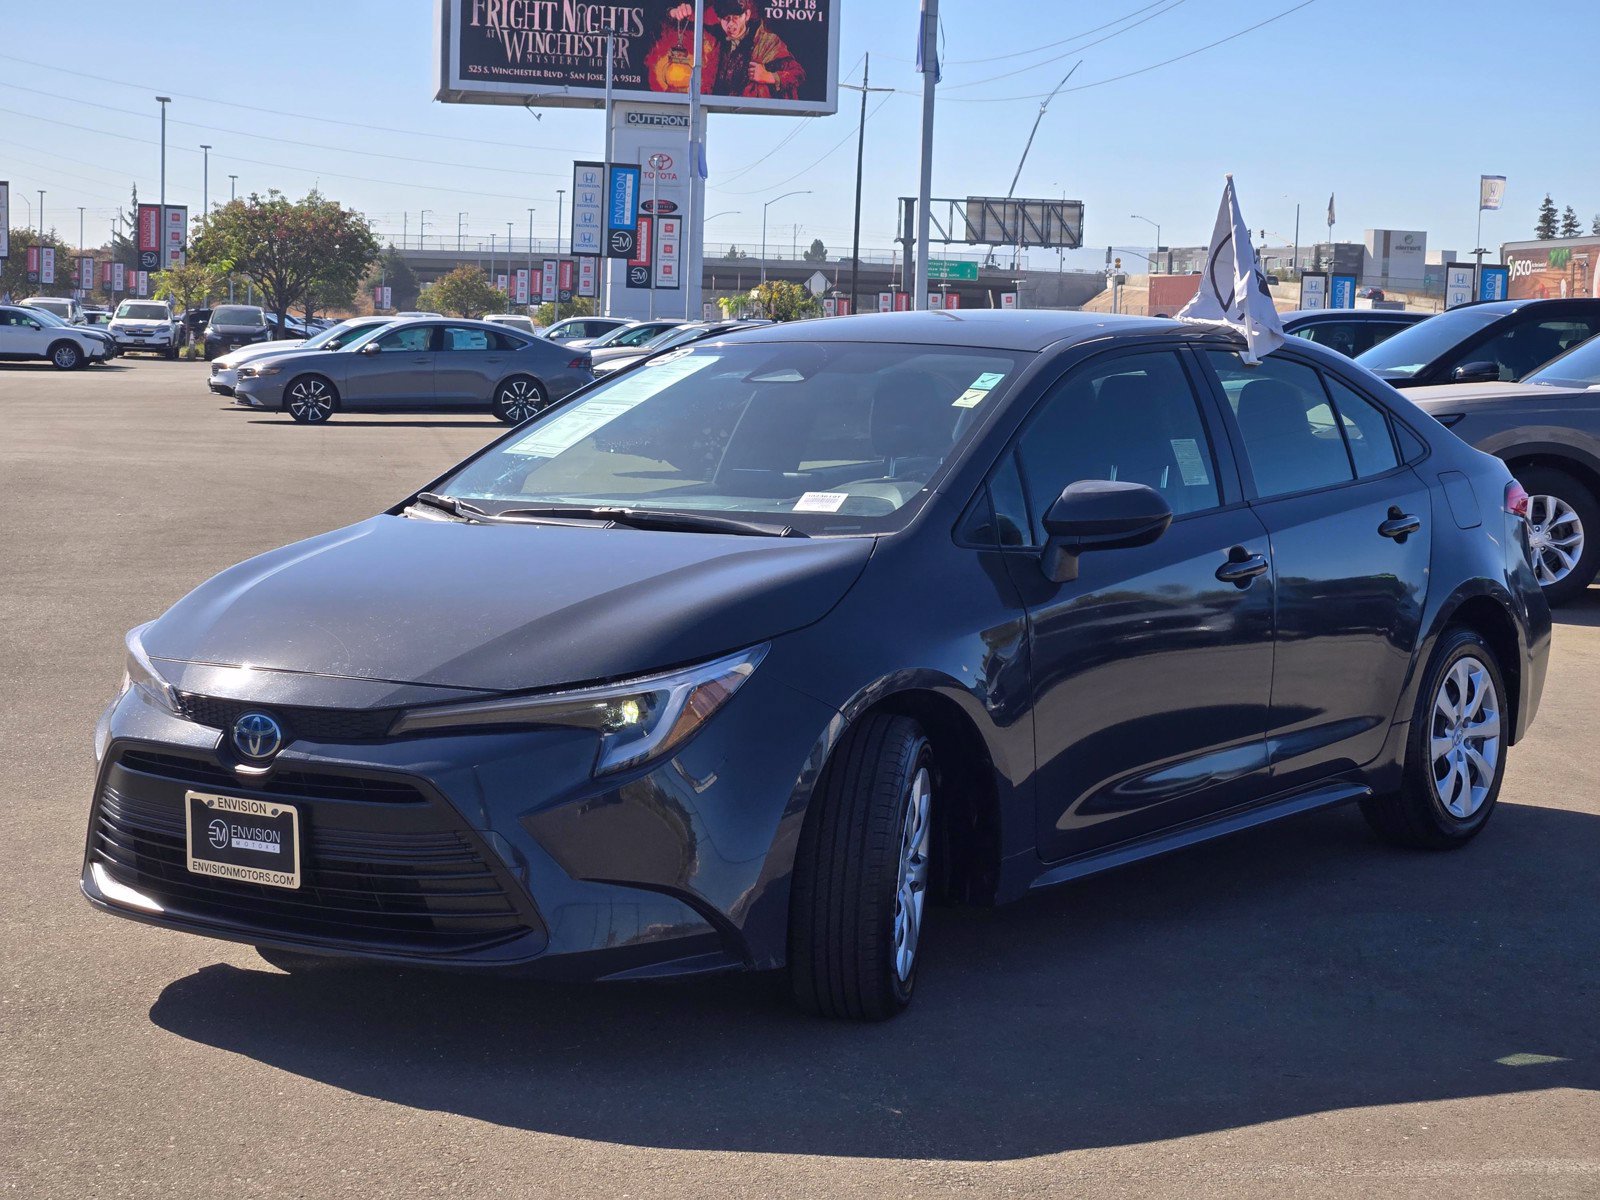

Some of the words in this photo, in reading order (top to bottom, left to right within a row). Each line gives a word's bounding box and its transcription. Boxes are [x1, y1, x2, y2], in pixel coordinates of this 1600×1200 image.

[771, 0, 799, 8] SEPT
[804, 0, 816, 9] 18
[470, 0, 558, 42] FRIGHT
[765, 7, 783, 19] TO
[786, 9, 816, 21] NOV
[818, 11, 823, 21] 1
[486, 29, 495, 38] AT
[501, 29, 631, 68] WINCHESTER
[526, 54, 580, 66] MYSTERY
[589, 57, 625, 69] HOSE
[468, 65, 482, 73] 525
[620, 75, 641, 83] 95128
[643, 172, 678, 181] TOOTA
[614, 172, 626, 225] ENVISION
[217, 797, 267, 814] ENVISION
[231, 825, 281, 843] ENVISION
[235, 840, 277, 851] MOTORS
[192, 861, 294, 886] ENVISIONMOTORS.COM
